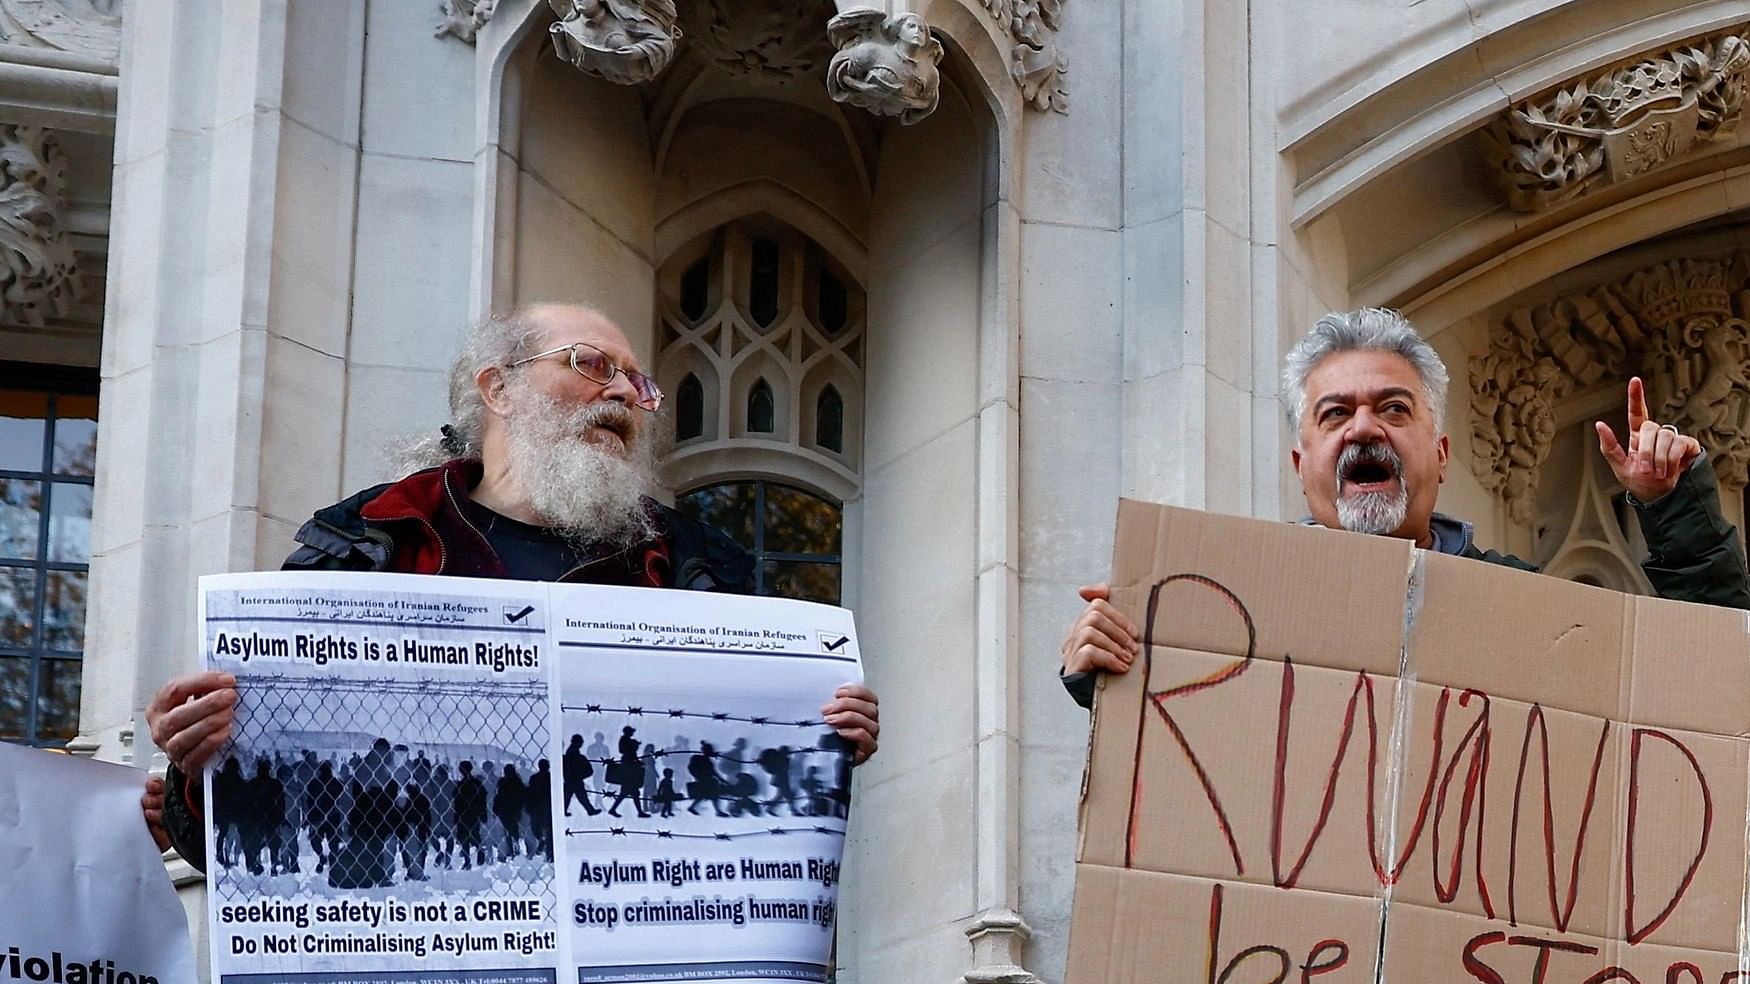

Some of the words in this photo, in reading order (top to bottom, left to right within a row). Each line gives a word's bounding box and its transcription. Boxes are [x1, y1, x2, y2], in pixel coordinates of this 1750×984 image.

[241, 597, 312, 606] International
[315, 597, 385, 609] Organisation
[388, 600, 398, 609] of
[401, 601, 440, 611] Iranian
[443, 603, 488, 614] Refugees
[566, 618, 636, 631] International
[639, 622, 706, 636] Organisation
[709, 626, 720, 636] of
[722, 626, 760, 638] Iranian
[763, 629, 807, 642] Refugees
[216, 633, 288, 663] Asylum
[296, 633, 357, 665] Rights
[364, 636, 380, 660] is
[386, 646, 398, 662] a
[404, 639, 468, 665] Human
[475, 642, 539, 672] Rights!
[579, 861, 646, 888] Asylum
[653, 860, 701, 886] Right
[706, 863, 735, 880] are
[741, 858, 802, 879] Human
[222, 902, 309, 927] seeking
[316, 901, 381, 928] safety
[389, 901, 406, 921] is
[414, 902, 448, 922] not
[454, 906, 467, 922] a
[473, 900, 540, 921] CRIME
[575, 903, 618, 927] Stop
[624, 899, 744, 925] criminalising
[750, 898, 808, 920] human
[232, 935, 257, 954] Do
[263, 934, 297, 954] Not
[303, 933, 425, 956] Criminalising
[432, 933, 498, 956] Asylum
[504, 932, 555, 954] Right!
